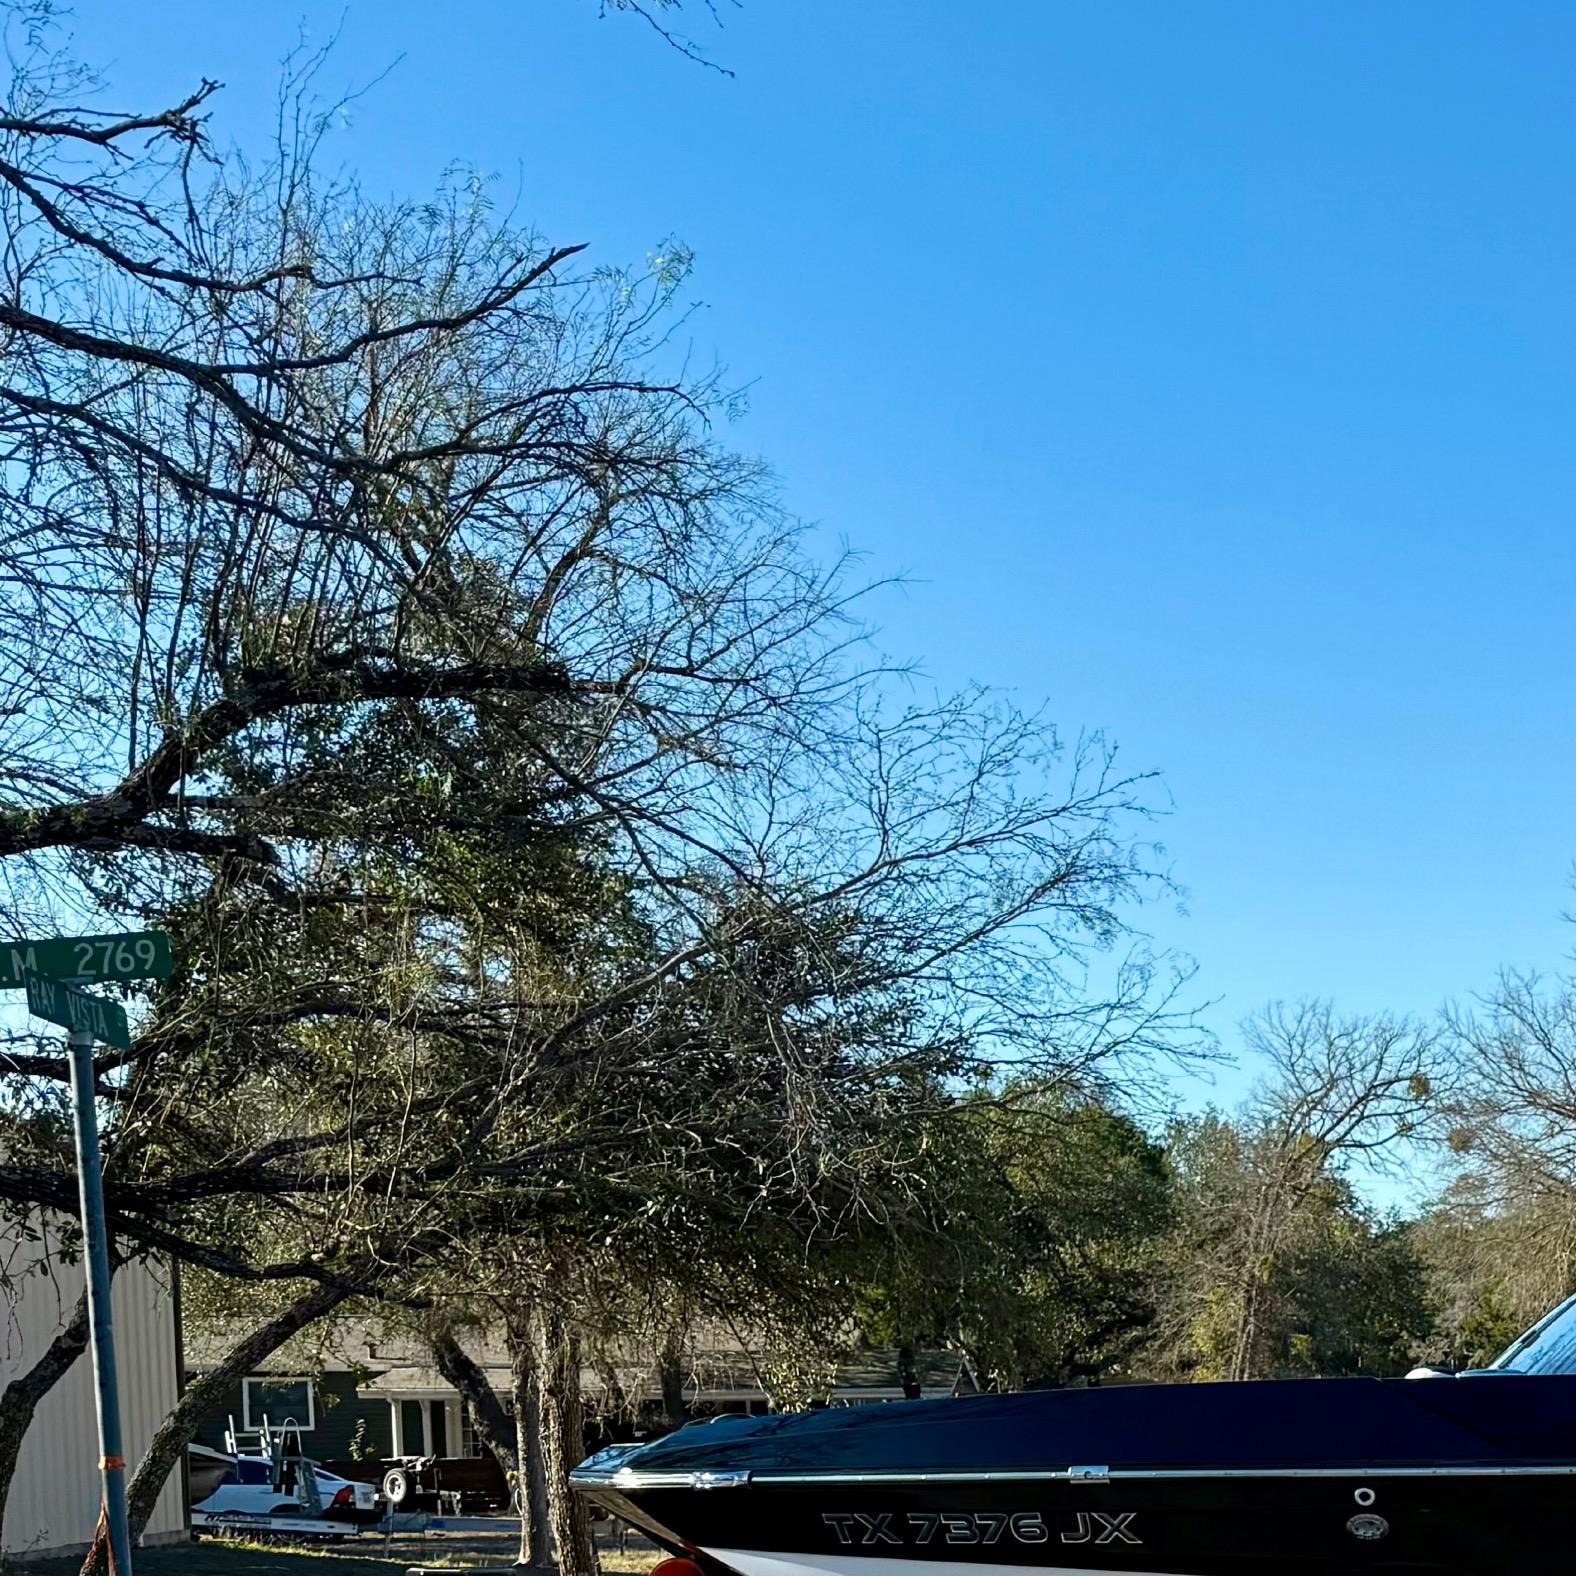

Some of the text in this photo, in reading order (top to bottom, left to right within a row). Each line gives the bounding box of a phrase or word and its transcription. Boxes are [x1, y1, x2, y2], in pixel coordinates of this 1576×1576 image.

[73, 939, 156, 975] 2769
[65, 990, 109, 1038] VISTA
[821, 1512, 1143, 1544] TX 7376 JX
